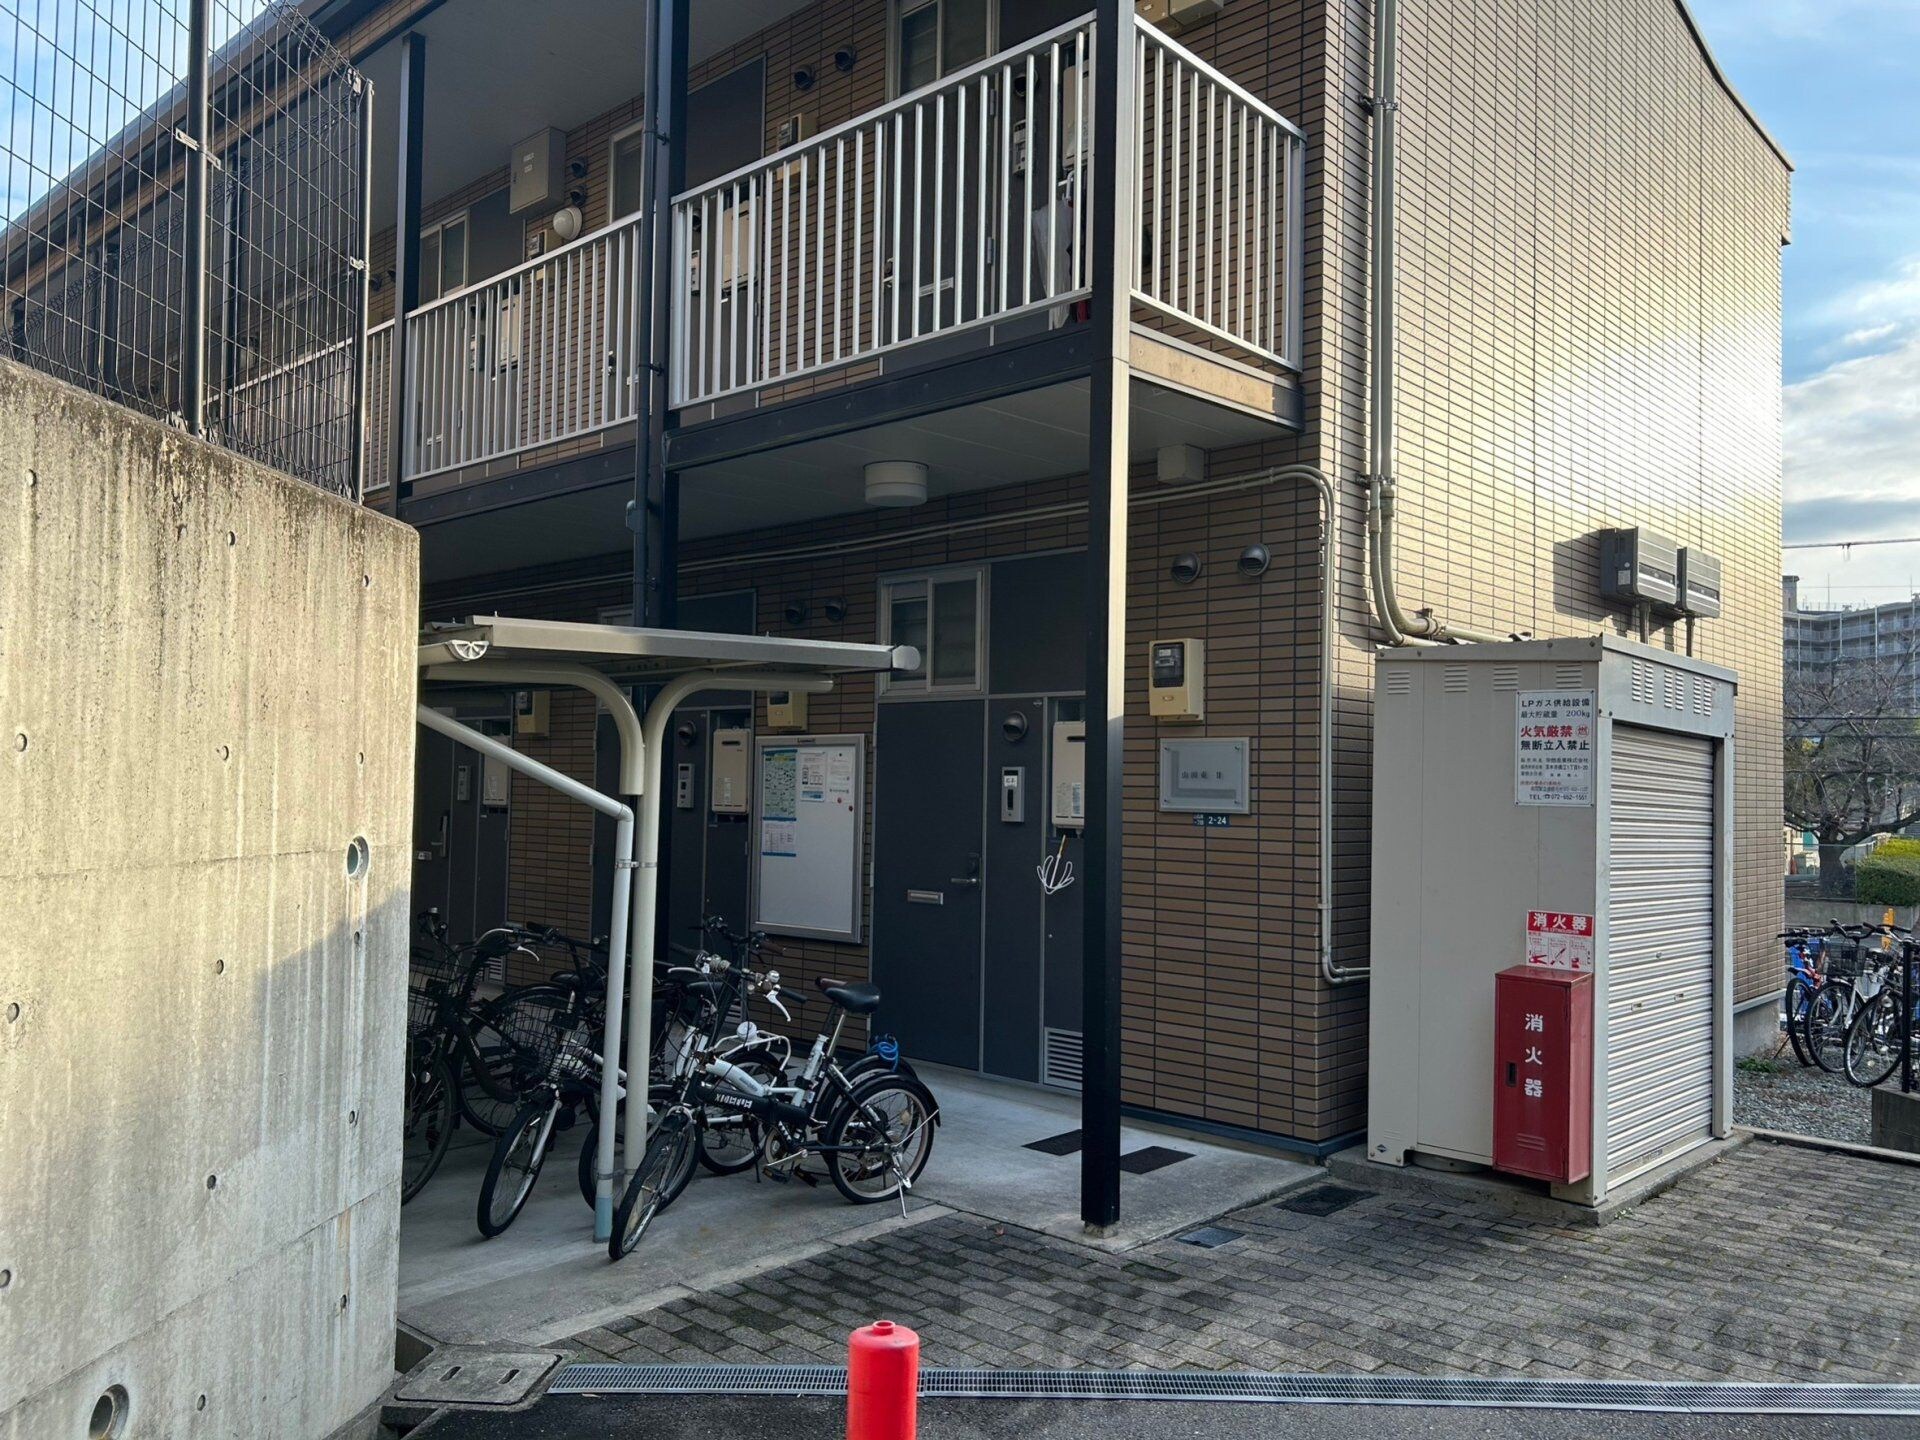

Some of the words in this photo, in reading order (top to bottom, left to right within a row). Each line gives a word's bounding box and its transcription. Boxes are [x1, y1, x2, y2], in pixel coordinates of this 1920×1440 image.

[1522, 699, 1590, 708] LPガス供給設備
[1565, 709, 1590, 718] 200kg
[1520, 724, 1572, 739] 火気厳禁
[1520, 740, 1590, 751] 無断立入禁止
[1208, 816, 1227, 825] 2-24
[1533, 912, 1588, 931] 消火器
[1524, 1013, 1543, 1098] 消火器
